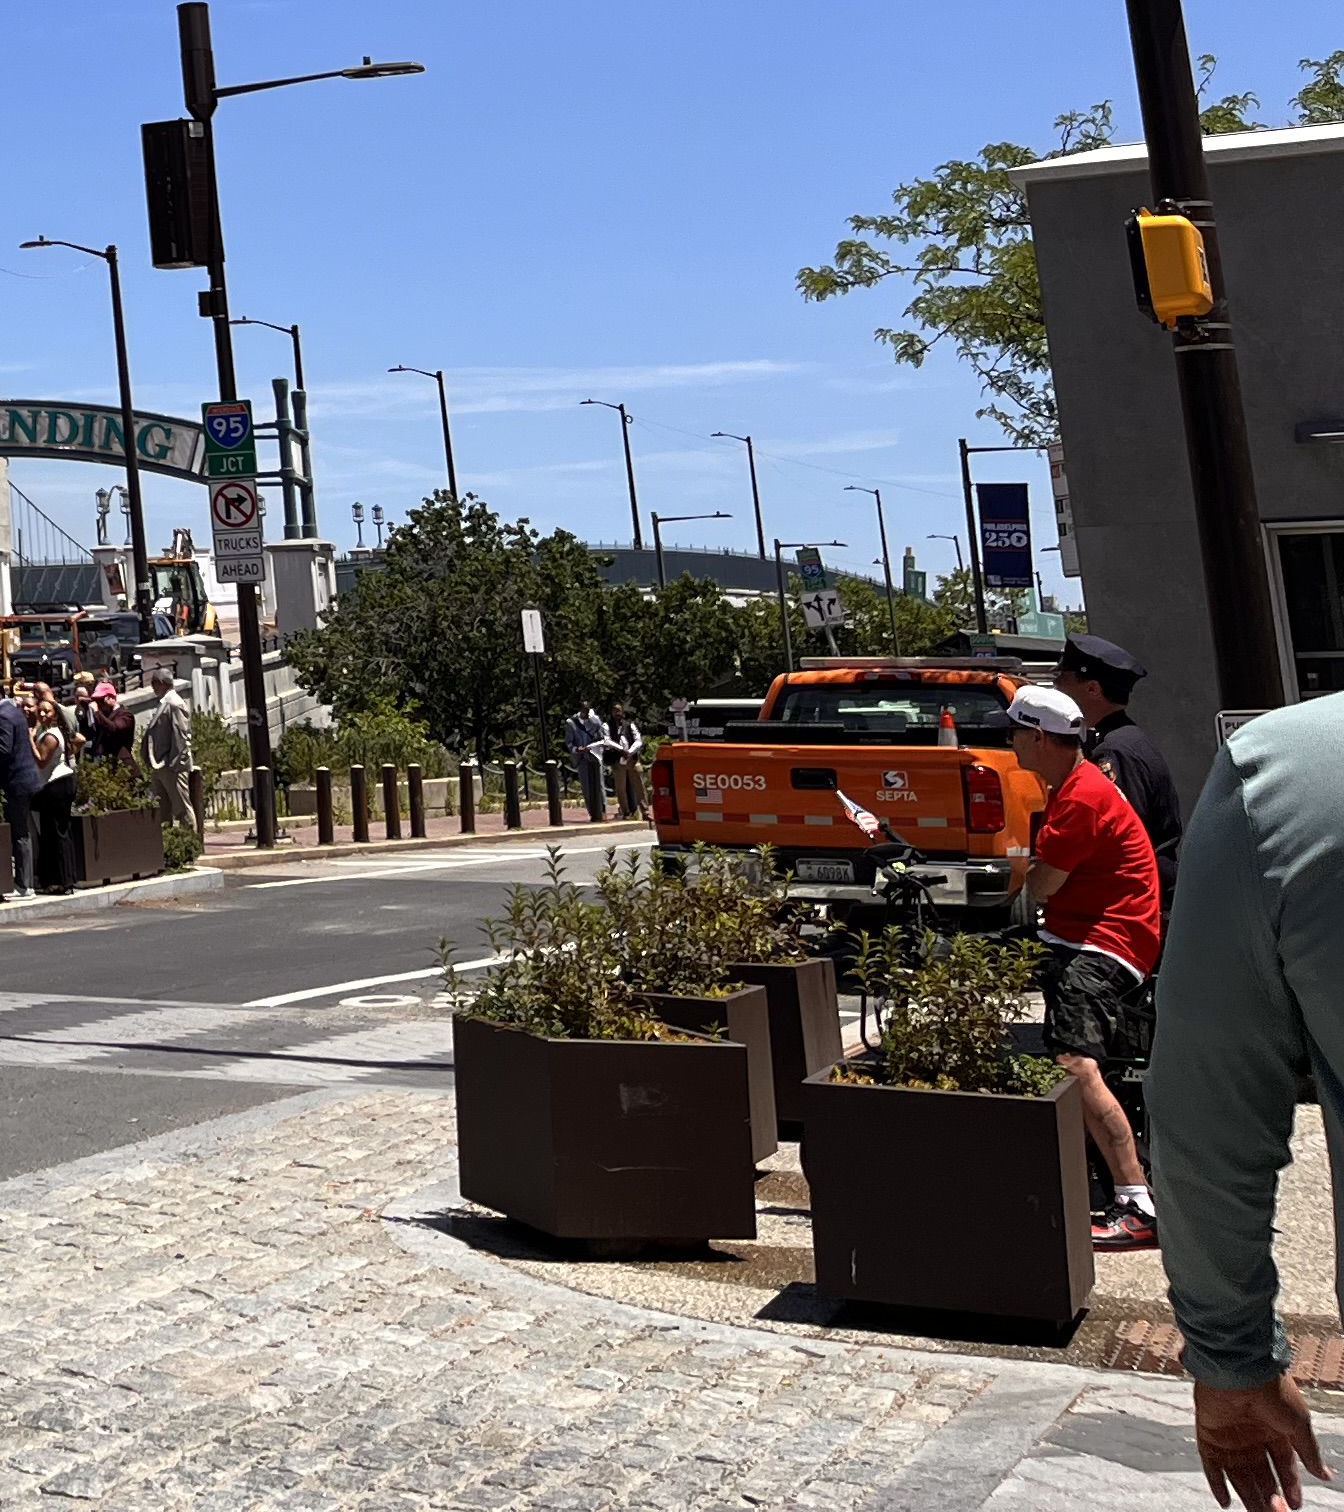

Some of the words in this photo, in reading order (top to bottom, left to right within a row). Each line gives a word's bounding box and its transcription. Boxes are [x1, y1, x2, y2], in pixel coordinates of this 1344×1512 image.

[213, 417, 244, 438] 95
[220, 456, 245, 473] JCT
[217, 537, 259, 550] TRUCKS
[984, 532, 1028, 548] 250
[222, 563, 259, 577] AHEAD
[693, 774, 767, 791] SE0053
[876, 790, 918, 802] SEPTA
